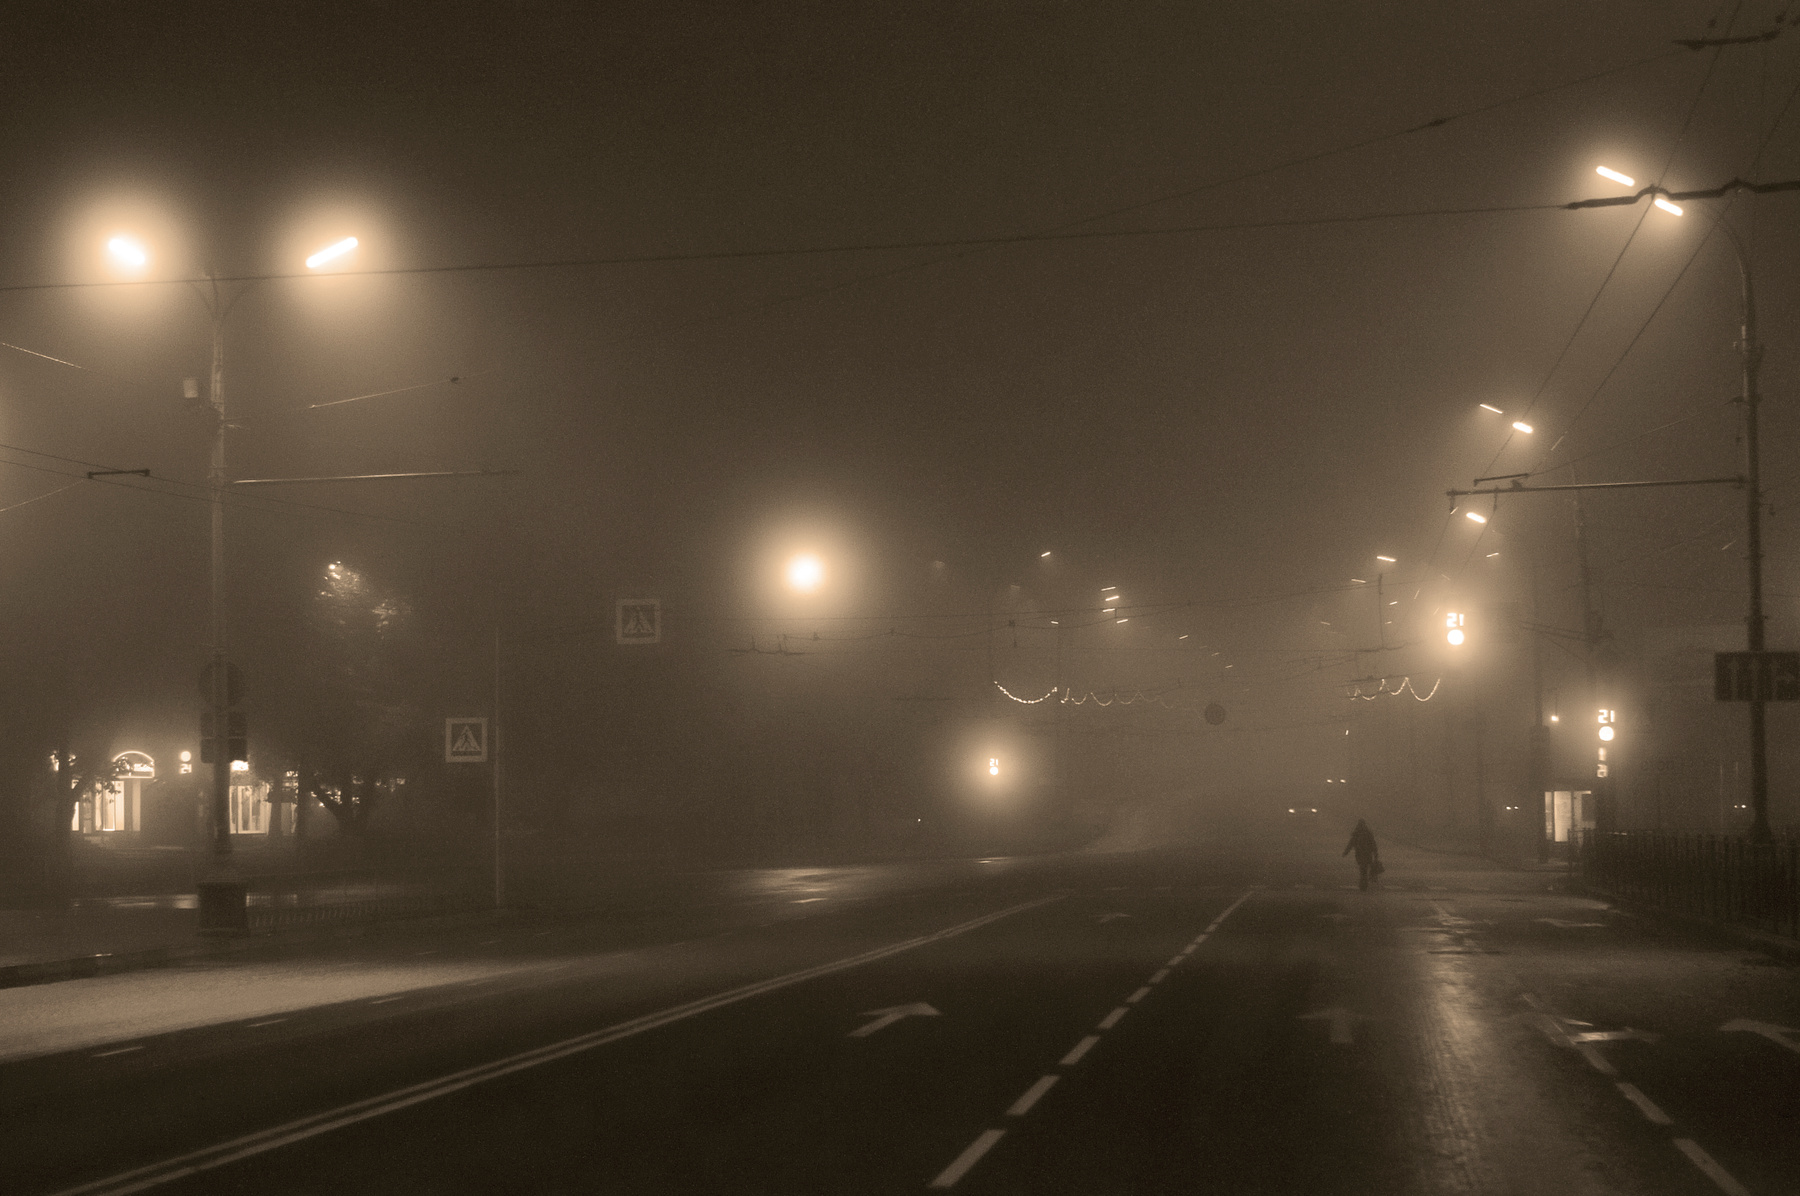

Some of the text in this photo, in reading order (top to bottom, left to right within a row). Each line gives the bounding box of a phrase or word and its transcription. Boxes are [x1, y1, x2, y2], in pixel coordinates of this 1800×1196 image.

[1446, 612, 1464, 628] 21
[1598, 709, 1615, 723] 21
[989, 758, 999, 767] 21
